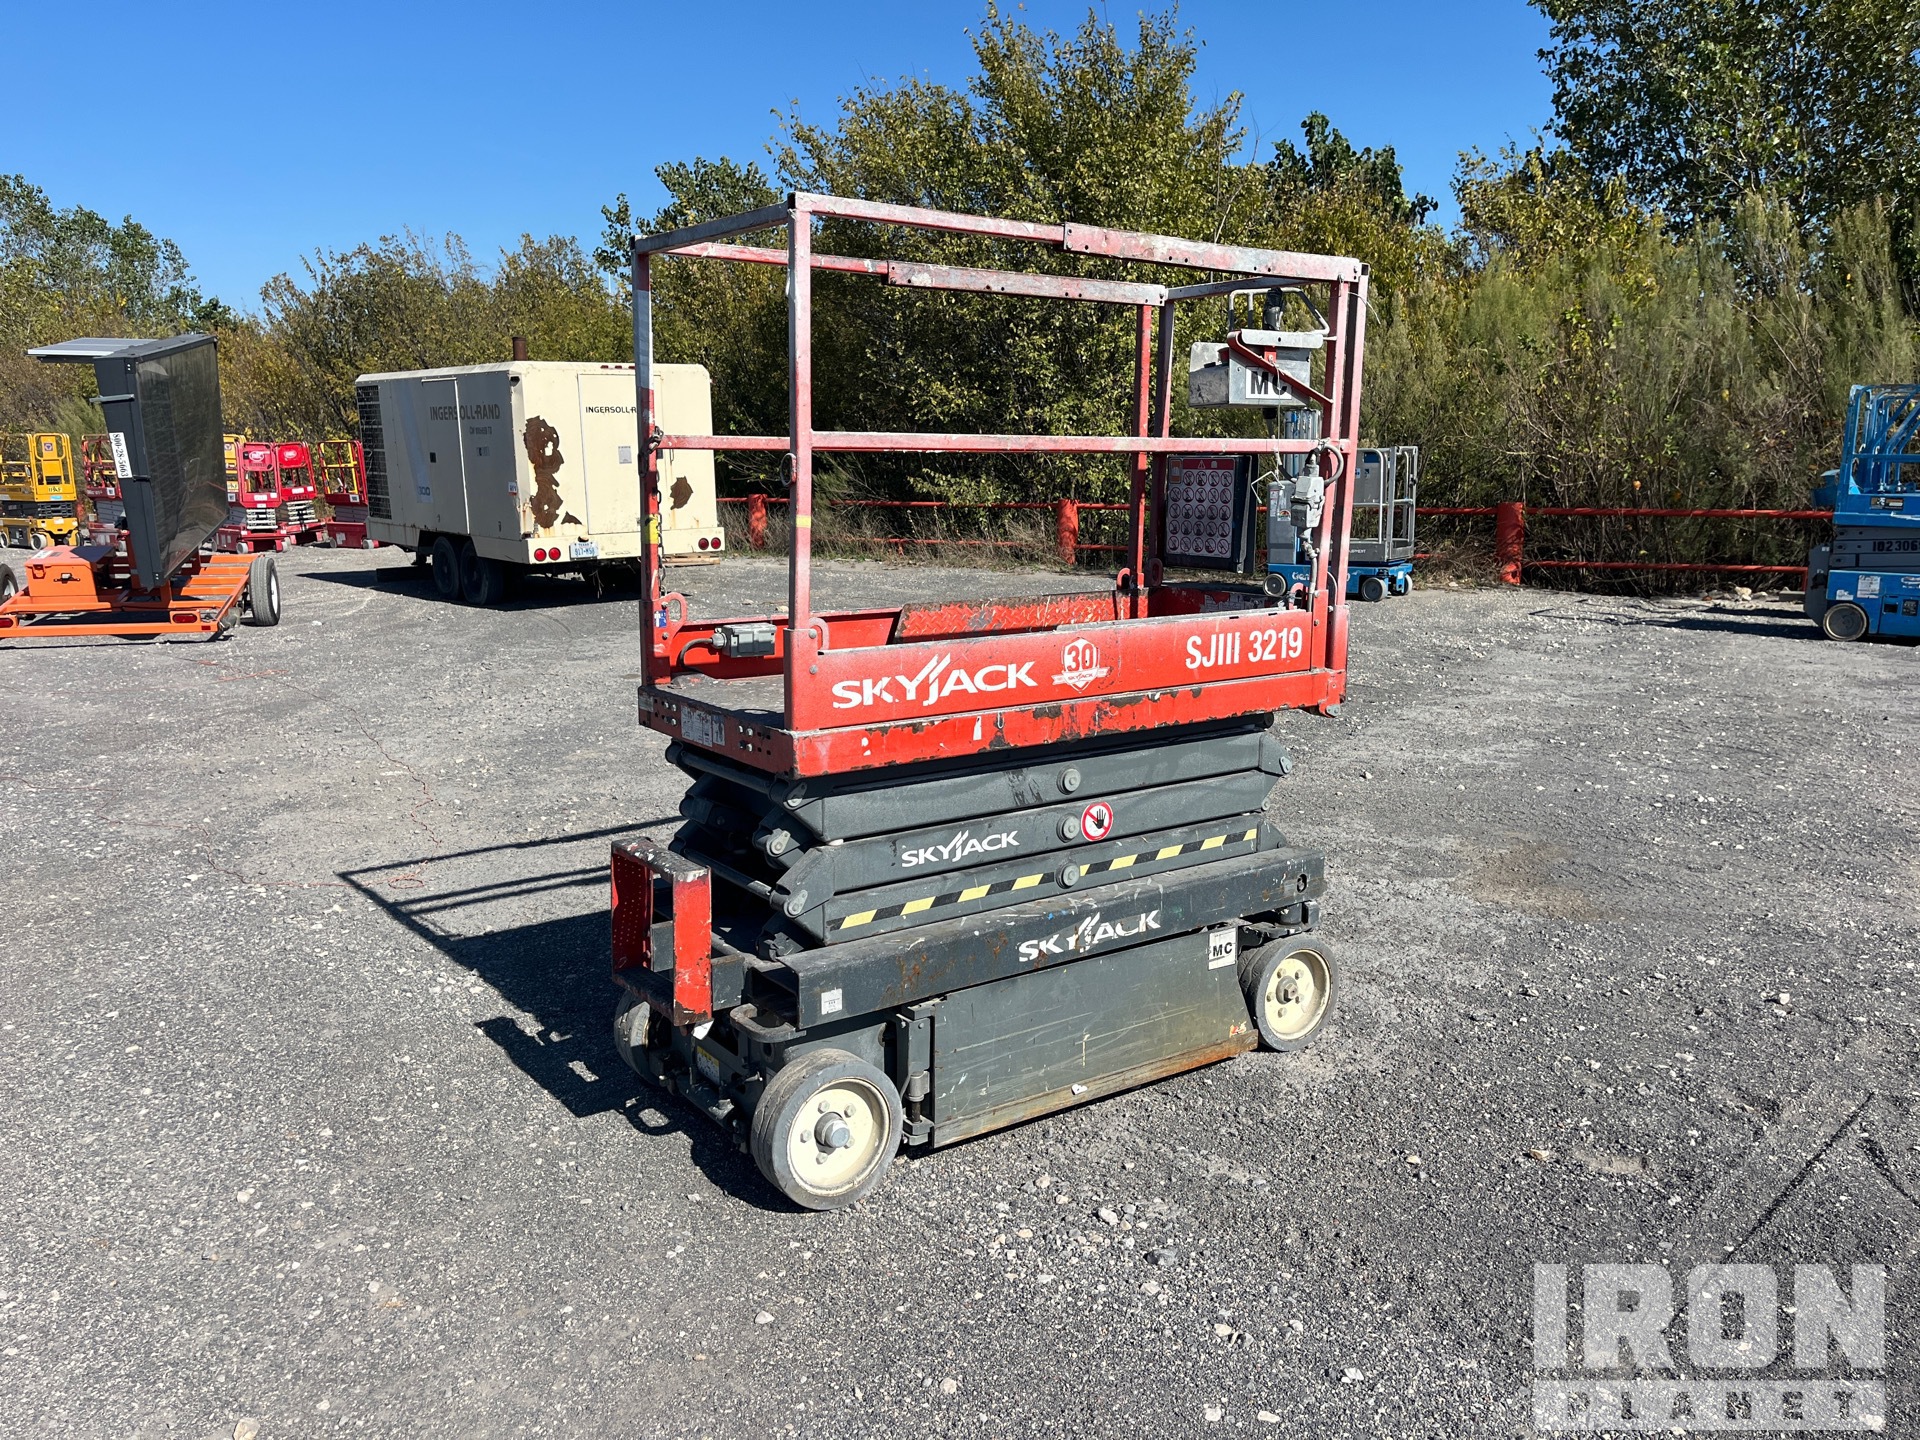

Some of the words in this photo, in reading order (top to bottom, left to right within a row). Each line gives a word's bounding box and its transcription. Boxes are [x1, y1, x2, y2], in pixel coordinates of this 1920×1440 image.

[1250, 370, 1288, 396] MC
[585, 406, 637, 414] INGERSOLL-R
[112, 434, 129, 478] 800-28-5663
[1067, 643, 1094, 672] 30
[1185, 631, 1241, 669] SJIII
[1248, 627, 1303, 663] 3219
[831, 653, 1038, 709] SKYJACK
[901, 830, 1020, 868] SKYJACK
[1018, 909, 1161, 962] SKYJACK
[1212, 942, 1233, 958] MC
